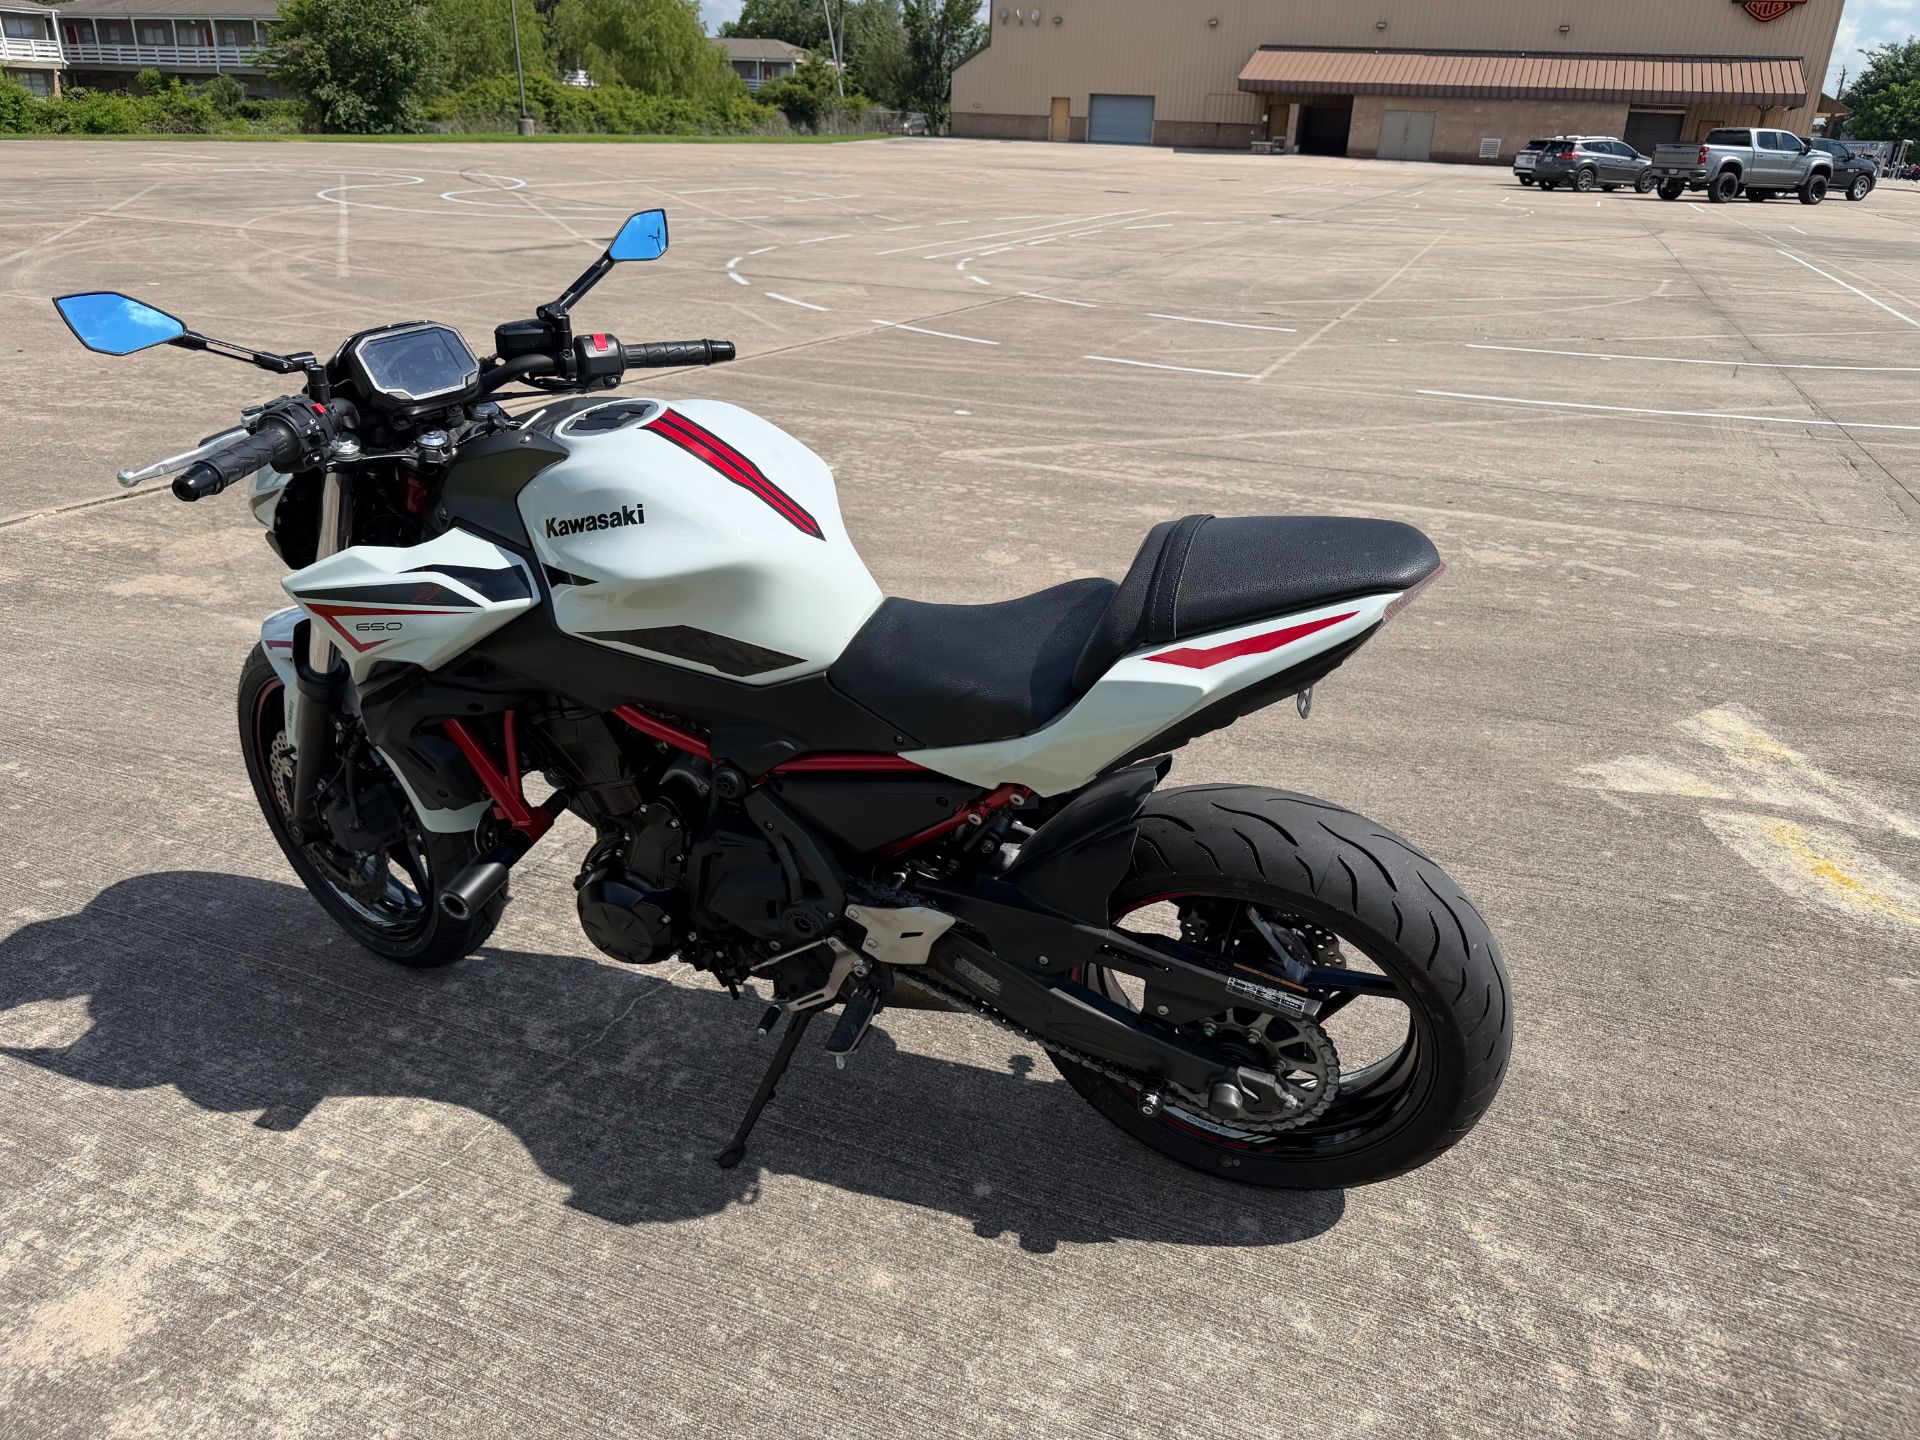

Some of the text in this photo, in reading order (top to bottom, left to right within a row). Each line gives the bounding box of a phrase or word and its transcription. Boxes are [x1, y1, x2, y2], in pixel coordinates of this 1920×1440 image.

[1750, 1, 1784, 17] CYCLES
[545, 503, 645, 539] Kawasaki
[356, 622, 402, 632] 650
